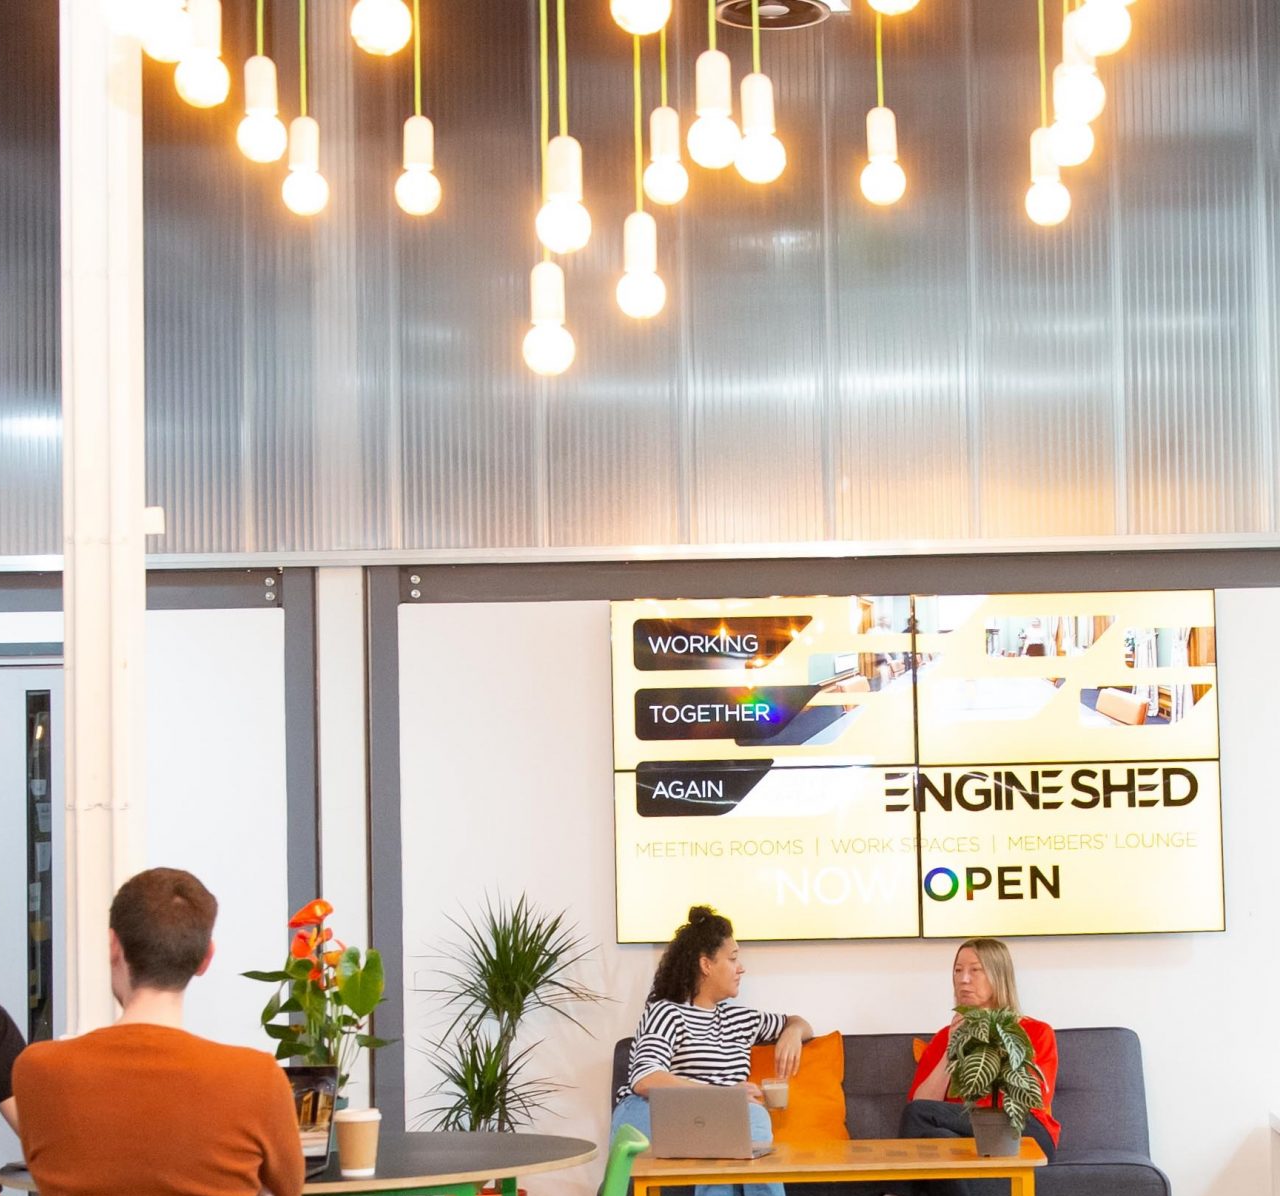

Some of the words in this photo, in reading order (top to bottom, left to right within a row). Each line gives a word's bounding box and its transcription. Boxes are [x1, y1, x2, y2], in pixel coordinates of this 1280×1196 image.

[648, 635, 758, 653] WORKING
[649, 704, 770, 723] TOGETHER
[652, 780, 723, 799] AGAIN
[635, 841, 723, 858] MEETING
[730, 839, 804, 856] ROOMS
[831, 837, 894, 854] WORK
[900, 836, 980, 853] SPACES
[1116, 832, 1198, 849] LOUNGE
[774, 866, 897, 906] NOW
[923, 865, 1061, 902] OPEN
